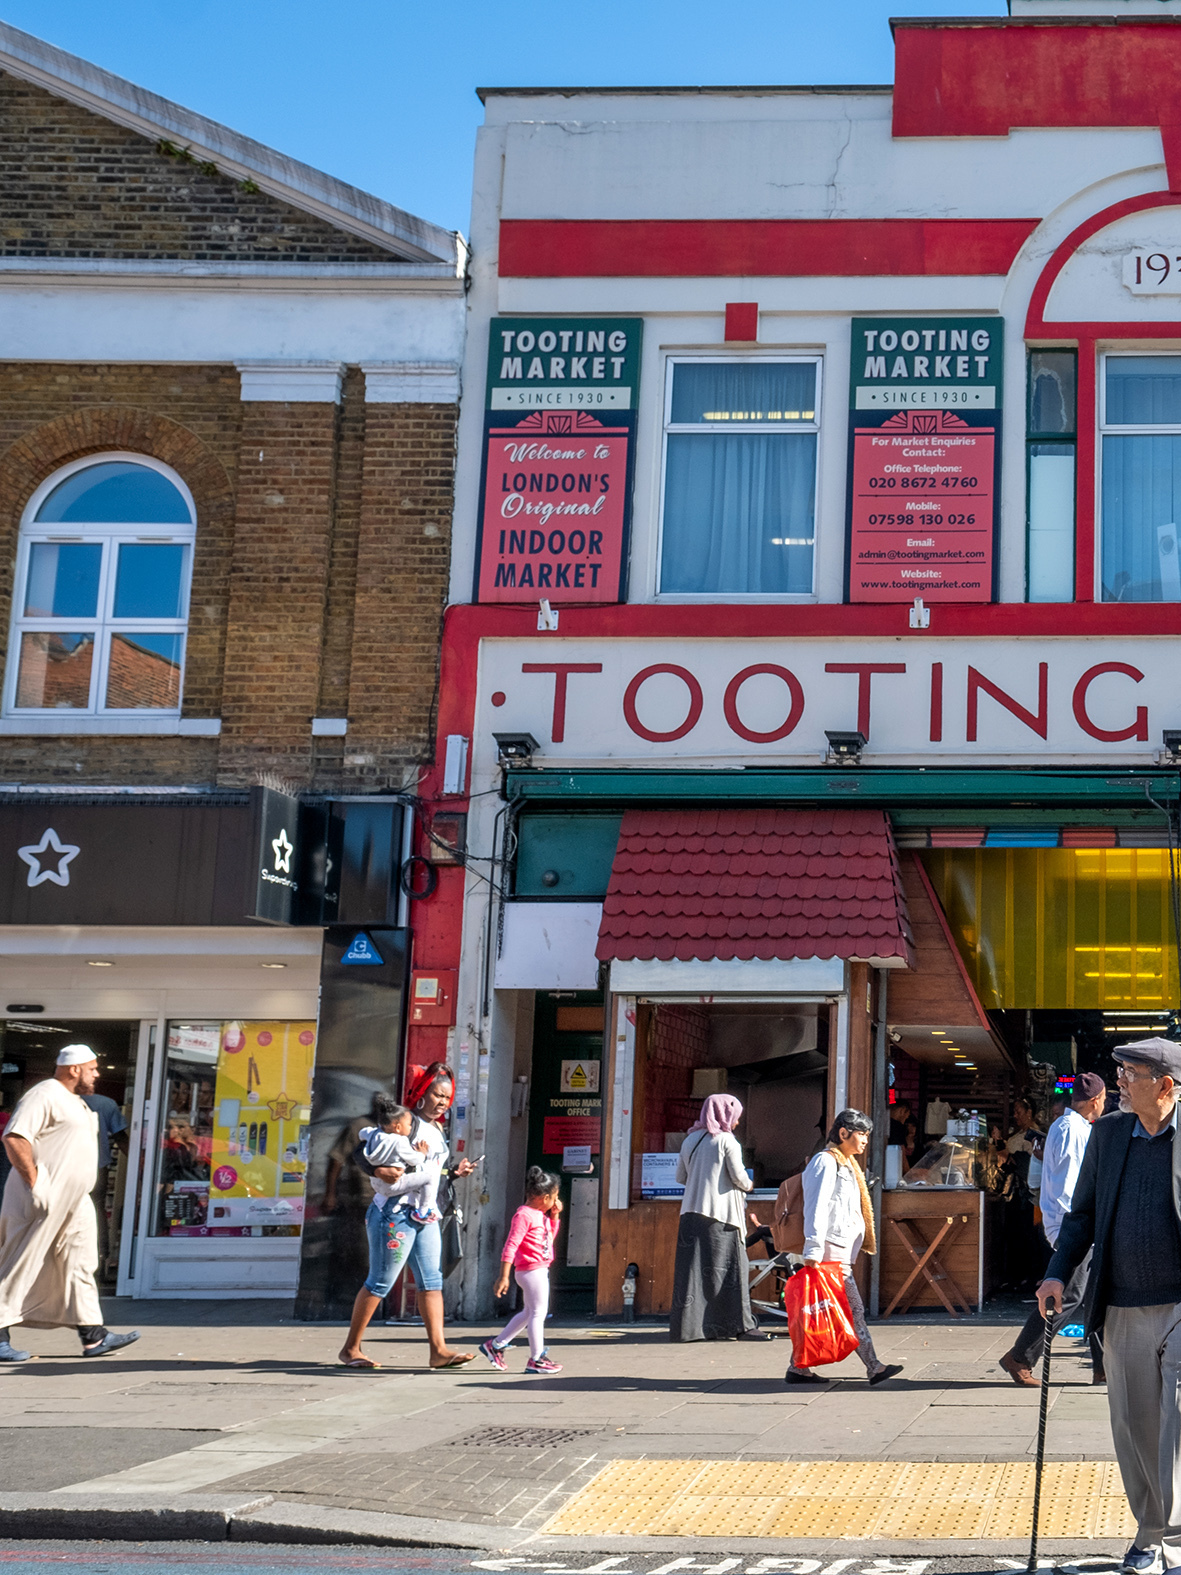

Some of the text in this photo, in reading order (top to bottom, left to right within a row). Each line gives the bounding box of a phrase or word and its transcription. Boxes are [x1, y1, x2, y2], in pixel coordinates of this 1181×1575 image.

[501, 331, 626, 352] TOOTING
[864, 330, 990, 351] TOOTING
[500, 357, 625, 379] MARKET
[864, 356, 989, 378] MARKET
[519, 393, 602, 403] SINCE 1930
[883, 393, 967, 403] SINCE 1930
[872, 438, 976, 447] For Market Enquiries
[504, 443, 610, 463] Welcome to
[902, 448, 945, 456] Contact:
[913, 465, 962, 474] Telephone:
[502, 473, 609, 492] LONDON'S
[869, 477, 978, 488] 020 8672 4760
[501, 493, 606, 525] Original
[906, 502, 940, 510] Mobile:
[869, 514, 975, 525] 07598 130 026
[499, 530, 602, 555] INDOOR
[858, 550, 984, 560] admin@tootingmarket.com
[494, 564, 602, 587] MARKET
[901, 570, 941, 578] Website:
[861, 581, 980, 590] www.tootingmarket.com
[522, 662, 1148, 743] TOOTING
[550, 1099, 601, 1107] TOOTING MARK
[567, 1108, 590, 1116] OFFICE
